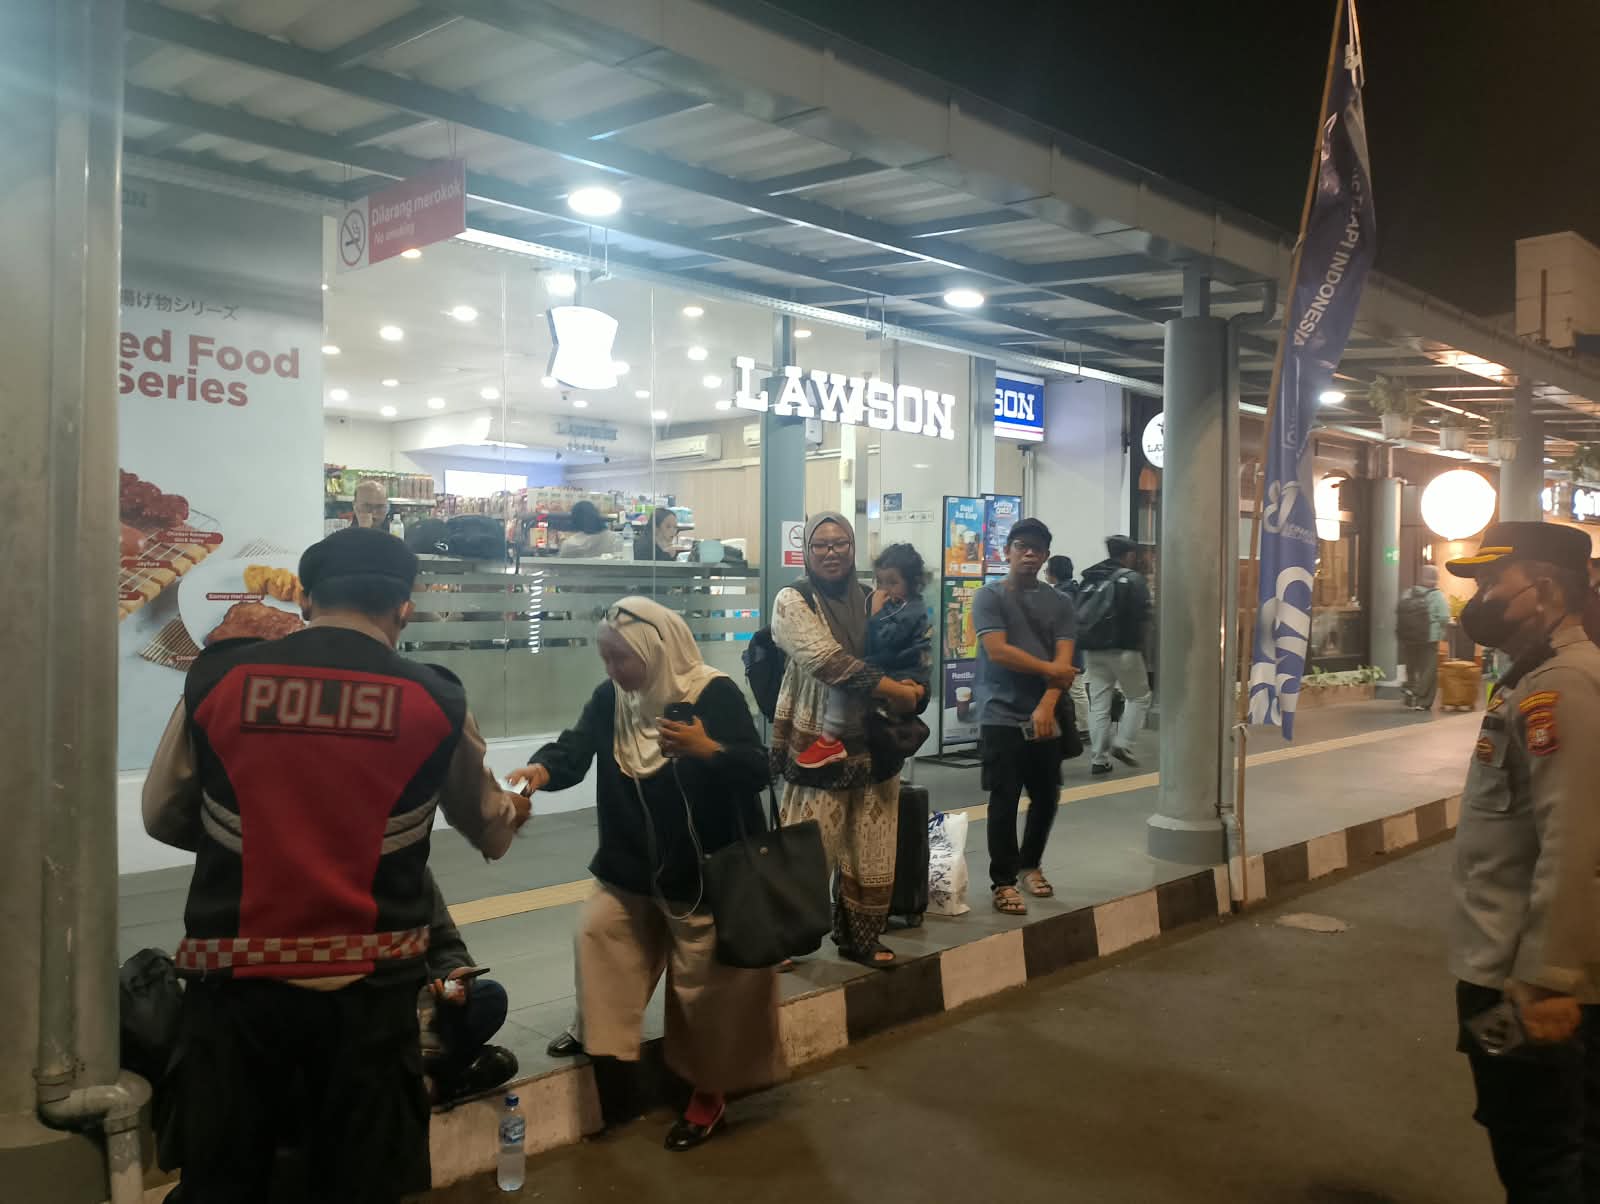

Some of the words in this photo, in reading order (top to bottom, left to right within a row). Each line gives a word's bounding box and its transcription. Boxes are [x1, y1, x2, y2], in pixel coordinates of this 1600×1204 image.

[371, 200, 413, 227] Dilarang
[414, 178, 461, 213] merokok
[1294, 251, 1350, 346] INDONESIA
[188, 334, 300, 379] Food
[735, 355, 956, 440] LAWSON
[244, 677, 396, 731] POLISI
